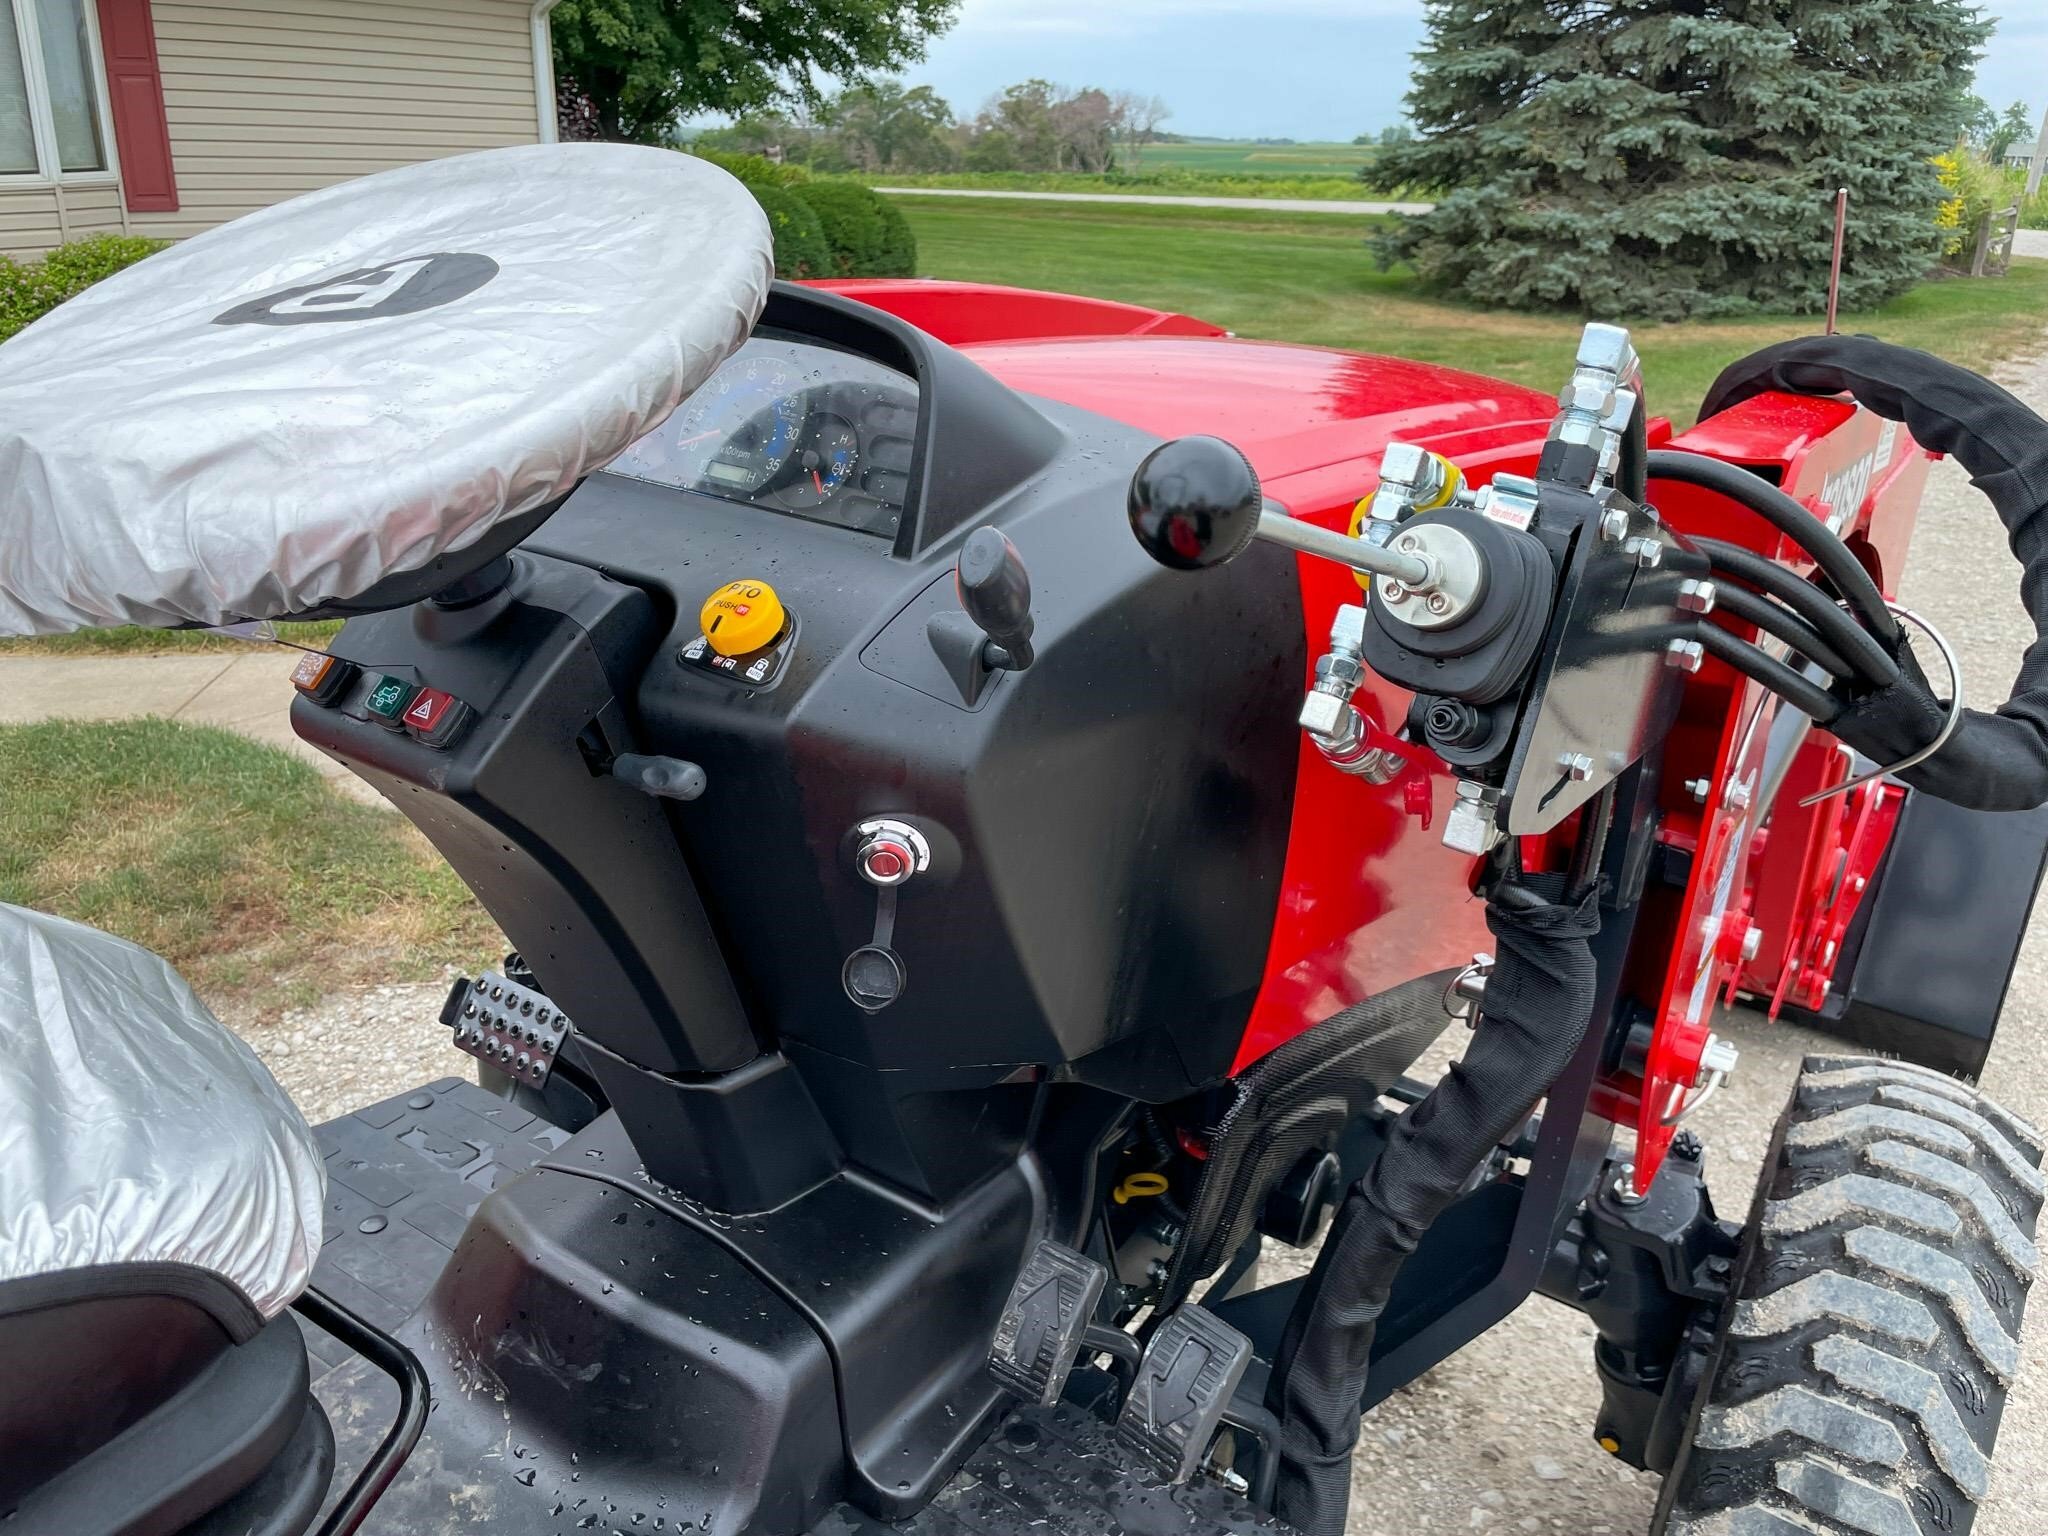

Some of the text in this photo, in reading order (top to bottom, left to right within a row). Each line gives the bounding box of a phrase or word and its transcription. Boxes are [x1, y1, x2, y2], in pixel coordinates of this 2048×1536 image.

[747, 369, 758, 380] 15
[771, 373, 786, 385] 20
[719, 384, 731, 395] 10
[784, 426, 800, 441] 30
[839, 434, 849, 444] H
[766, 458, 782, 472] 35
[746, 472, 756, 483] H
[727, 583, 762, 599] PTO
[714, 600, 738, 610] PUSH
[747, 667, 762, 679] AUTO
